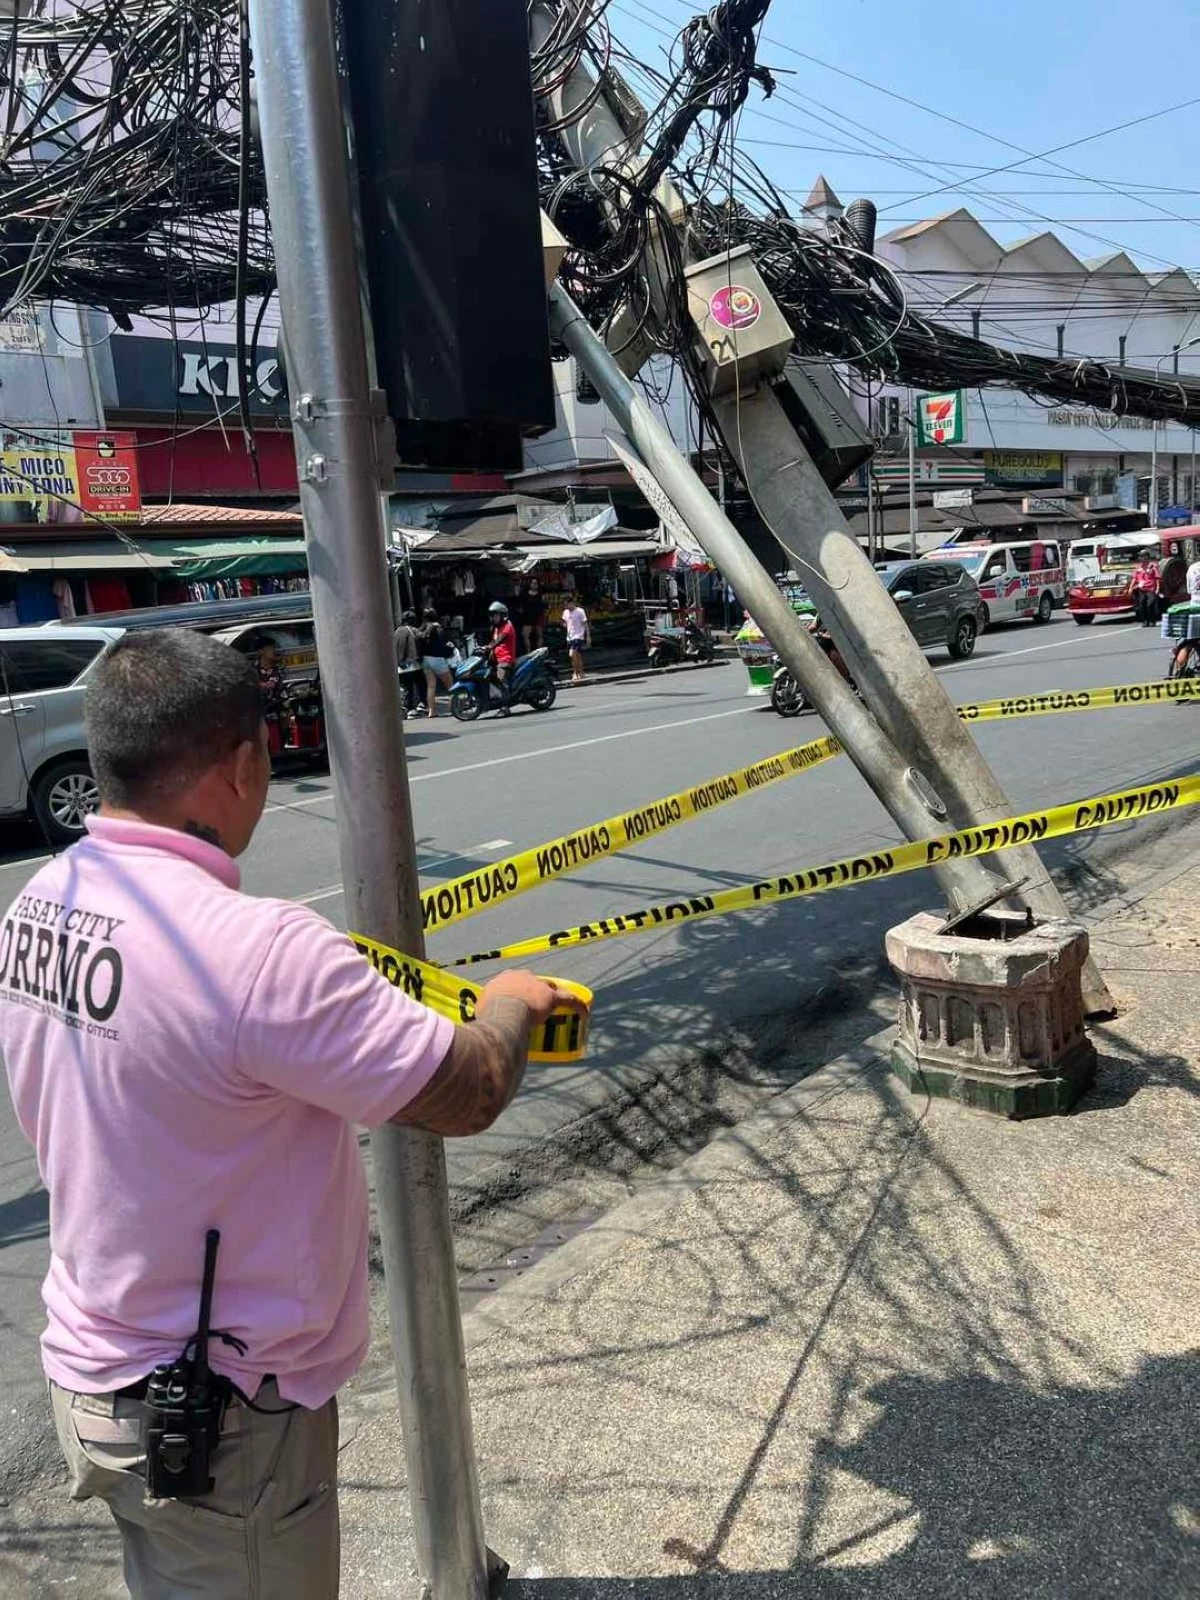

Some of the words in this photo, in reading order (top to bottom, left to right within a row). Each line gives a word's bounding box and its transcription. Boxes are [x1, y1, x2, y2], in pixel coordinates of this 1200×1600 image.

[20, 457, 66, 475] MICO
[927, 816, 1048, 864] CAUTION
[1075, 785, 1180, 829] CAUTION
[14, 895, 66, 928] PASAY
[65, 908, 125, 942] CITY
